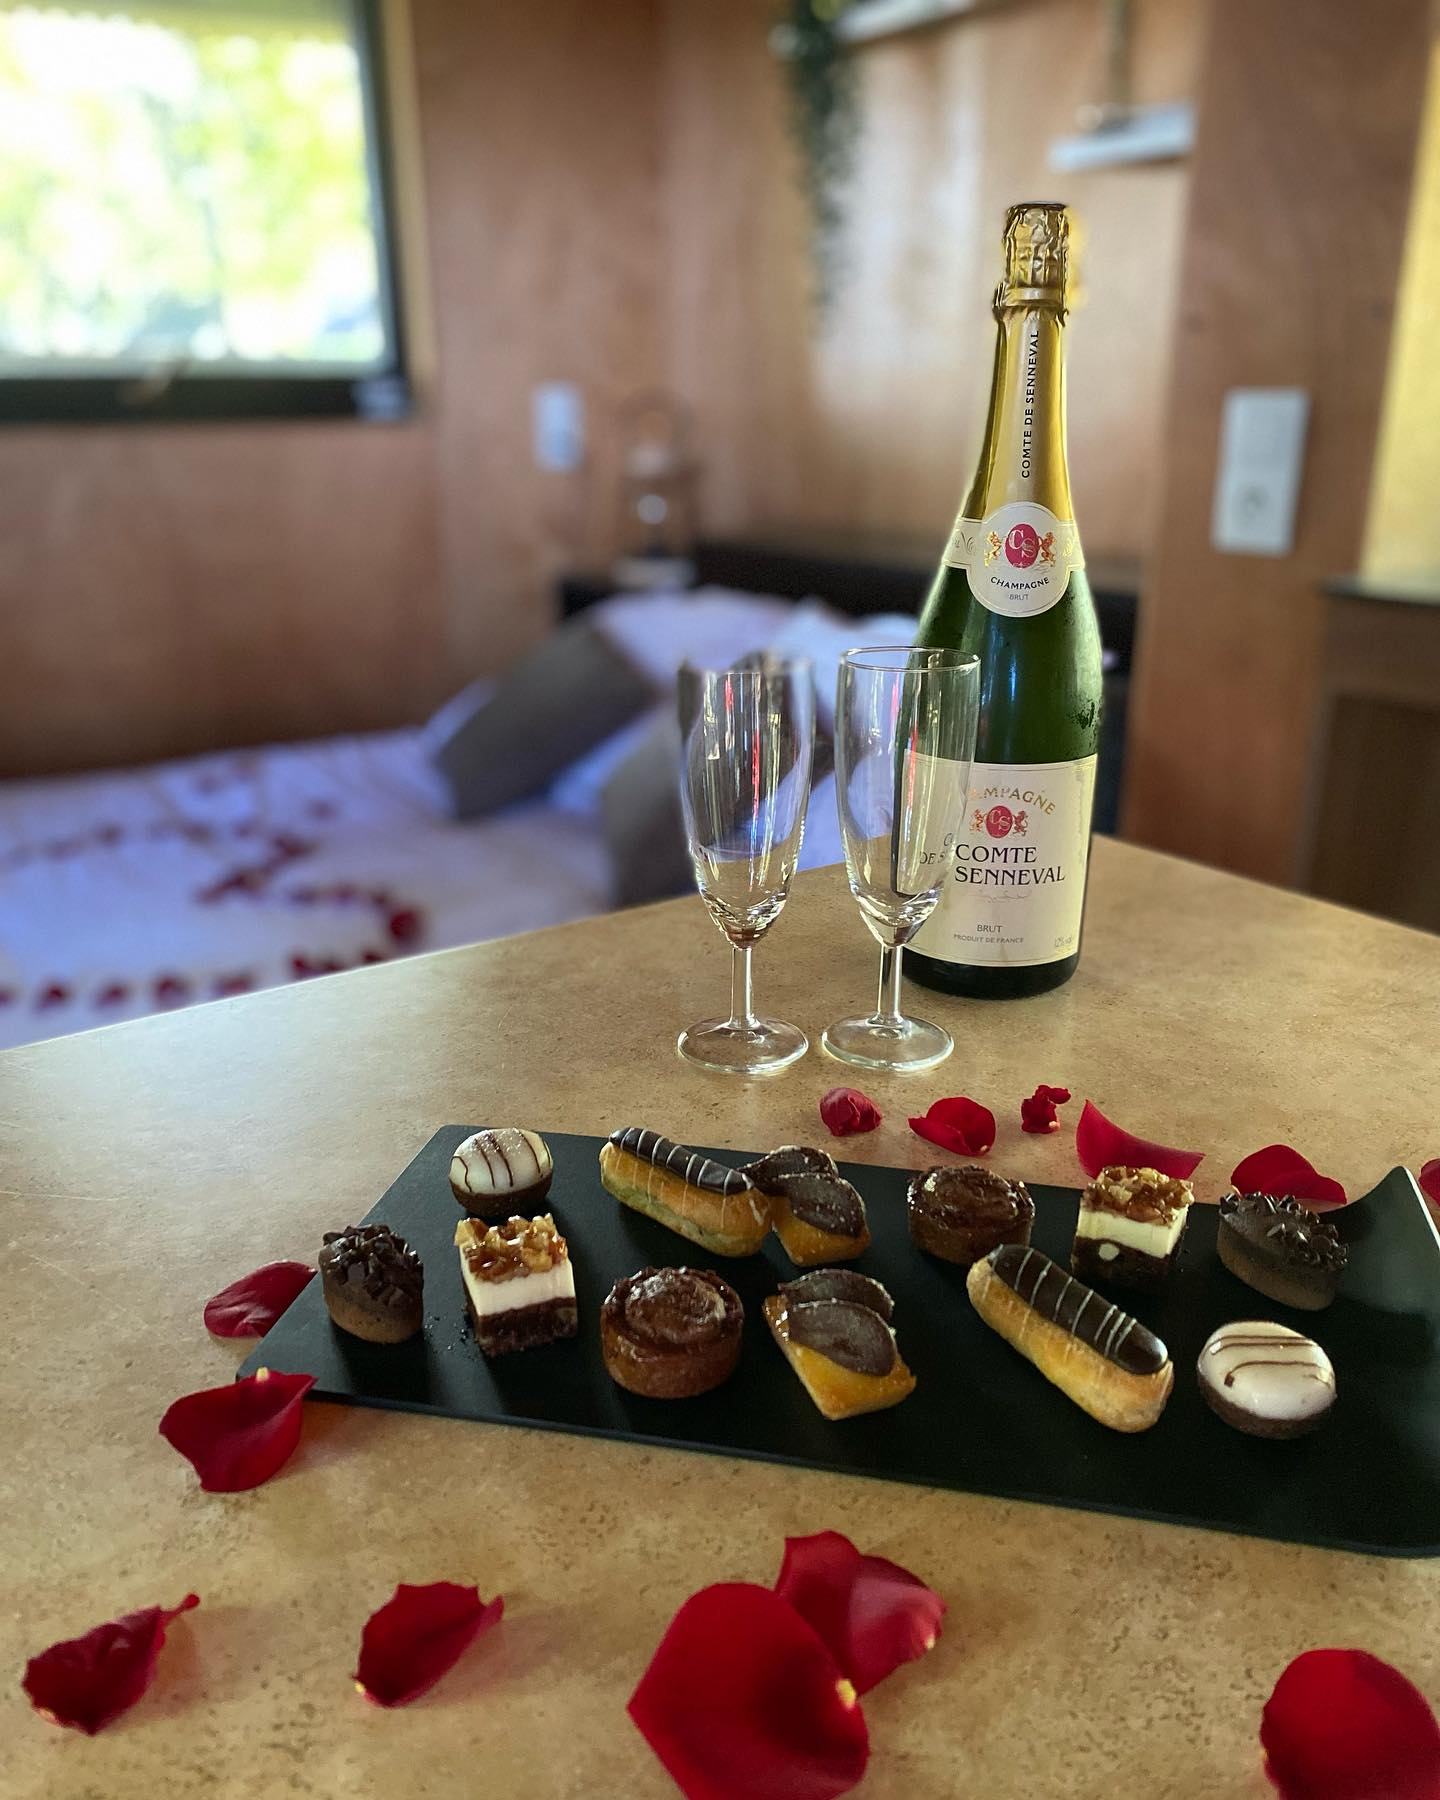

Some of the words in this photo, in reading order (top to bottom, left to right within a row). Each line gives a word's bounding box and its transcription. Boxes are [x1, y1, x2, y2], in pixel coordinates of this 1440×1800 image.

[1025, 330, 1039, 404] SENNEVAL
[1024, 408, 1034, 425] DE
[1021, 430, 1032, 478] COMTE
[990, 576, 1050, 590] CHAMPAGNE
[1009, 593, 1029, 601] BRUT
[955, 844, 1037, 864] COMTE
[955, 866, 1065, 886] SENNEVAL
[976, 924, 1004, 933] BRUT
[953, 934, 983, 943] PRODUIT
[985, 936, 996, 944] DE
[997, 936, 1024, 944] FRANCE
